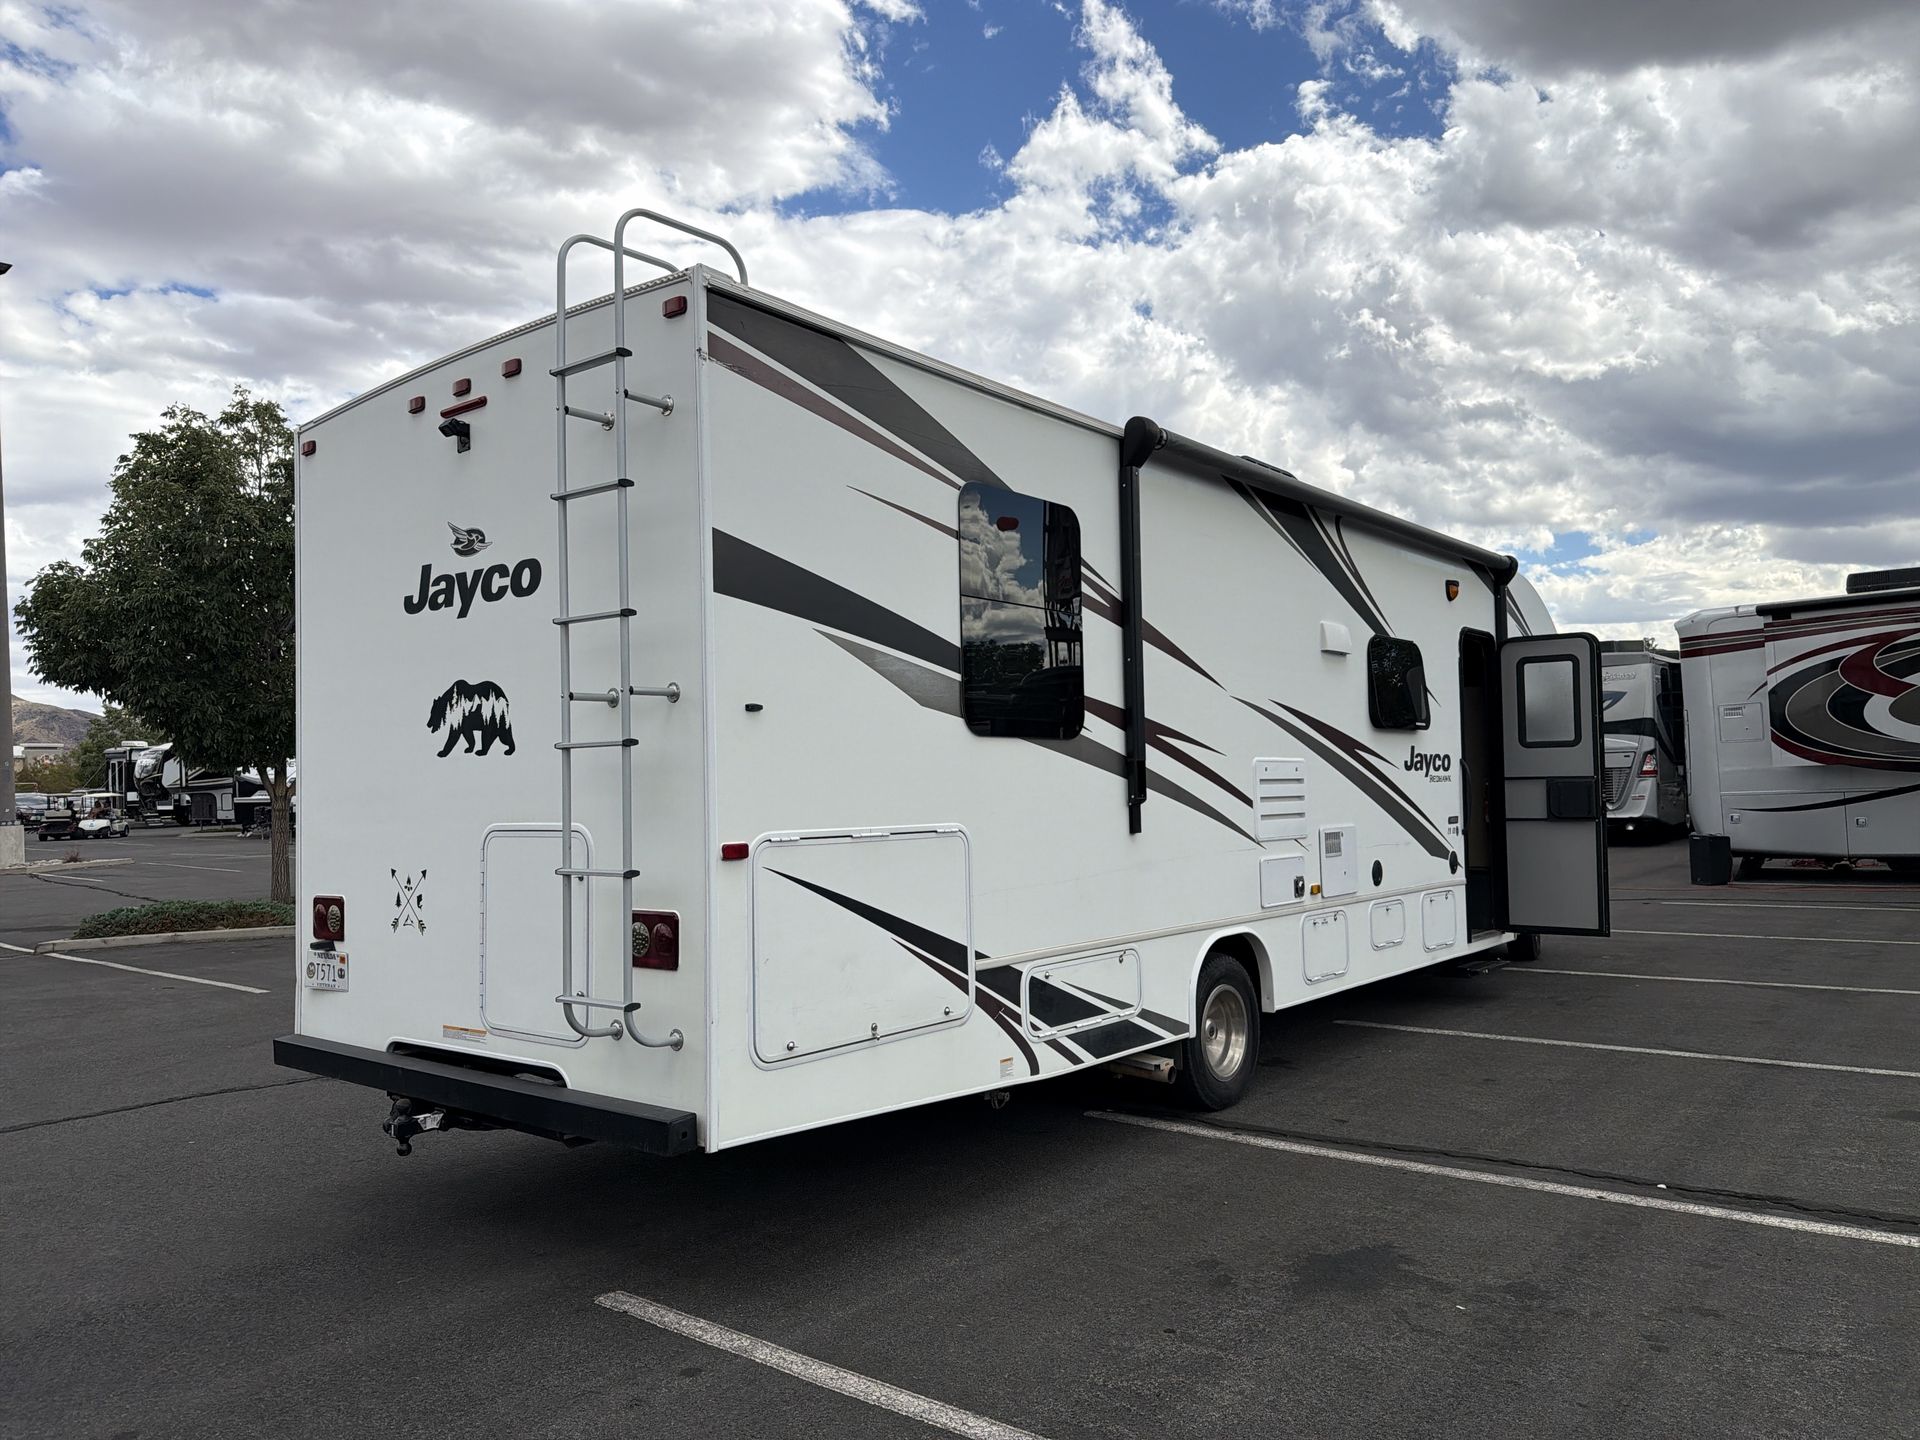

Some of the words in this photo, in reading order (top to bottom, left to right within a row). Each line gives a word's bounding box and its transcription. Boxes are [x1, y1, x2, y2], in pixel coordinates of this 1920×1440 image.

[404, 558, 542, 619] Jayco
[1404, 745, 1451, 777] Jayco
[317, 952, 336, 960] NEVADA
